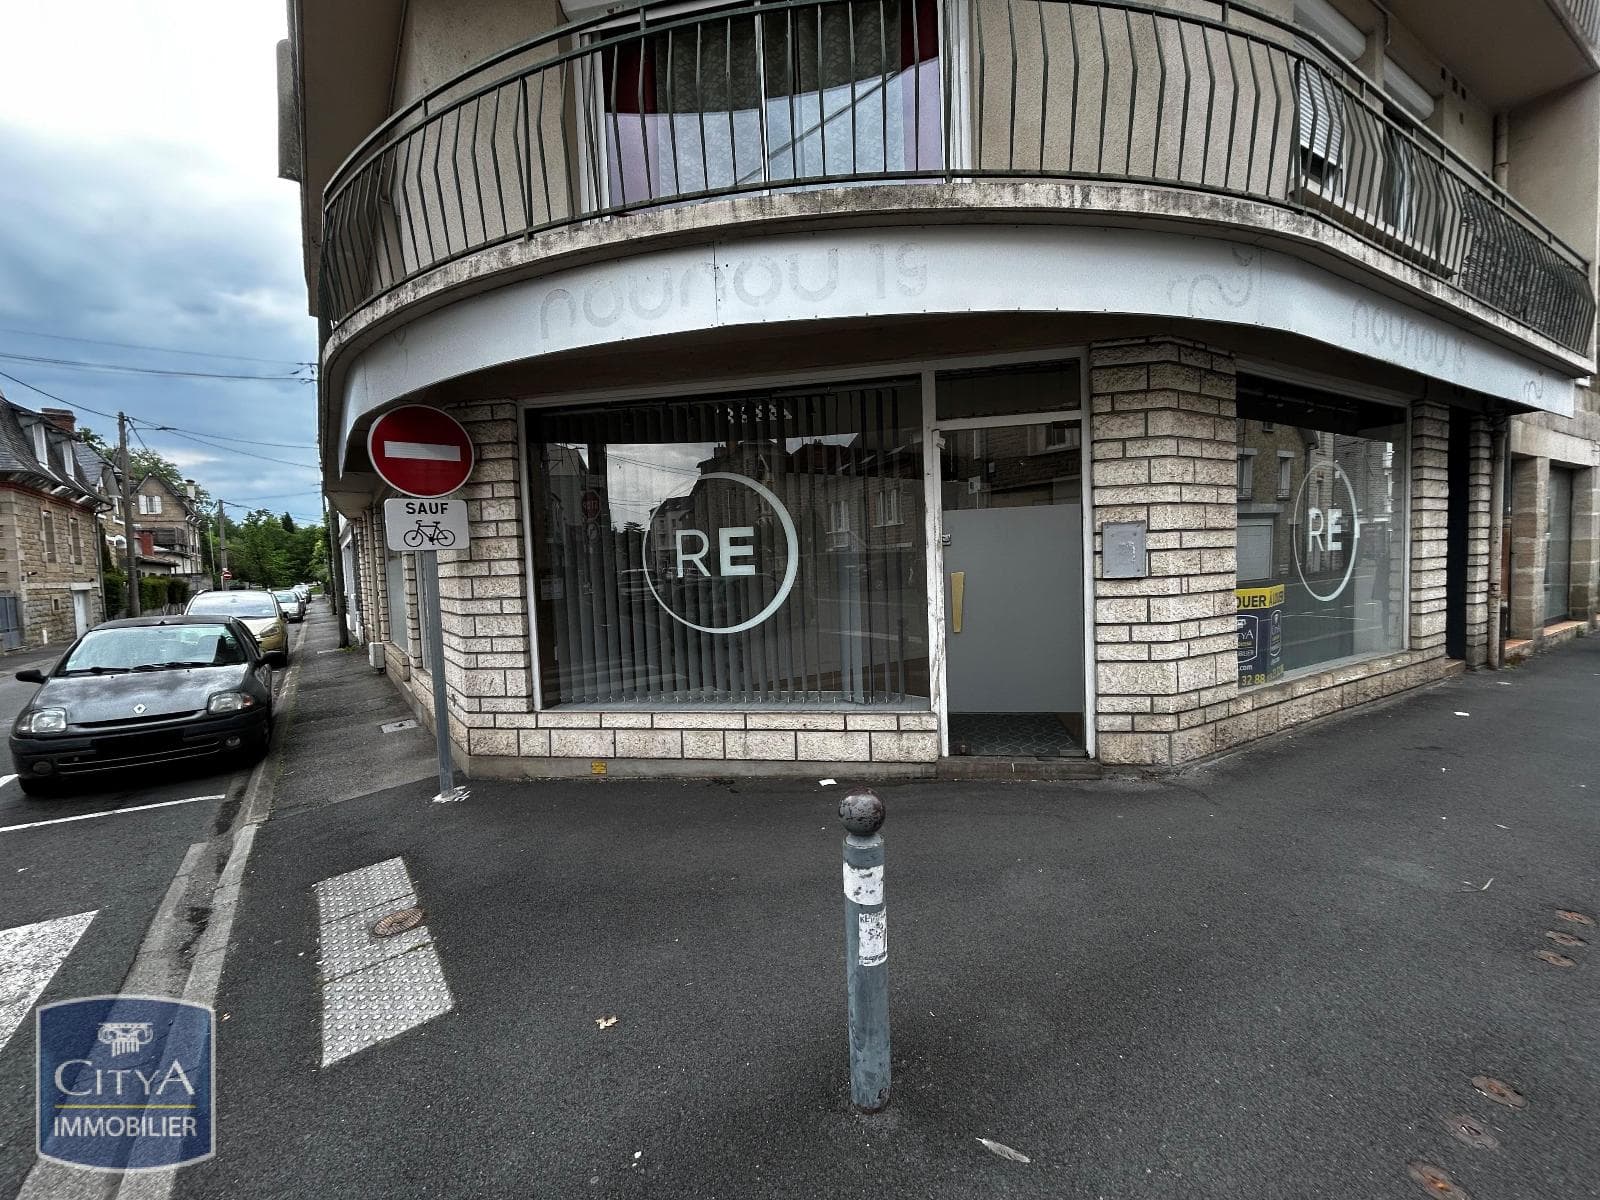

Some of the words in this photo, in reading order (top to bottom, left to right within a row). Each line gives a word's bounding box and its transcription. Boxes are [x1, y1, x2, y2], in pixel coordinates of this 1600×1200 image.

[406, 502, 449, 515] SAUF
[1308, 507, 1342, 553] RE
[676, 526, 756, 578] RE
[1241, 675, 1253, 686] 32
[1254, 673, 1266, 685] 88
